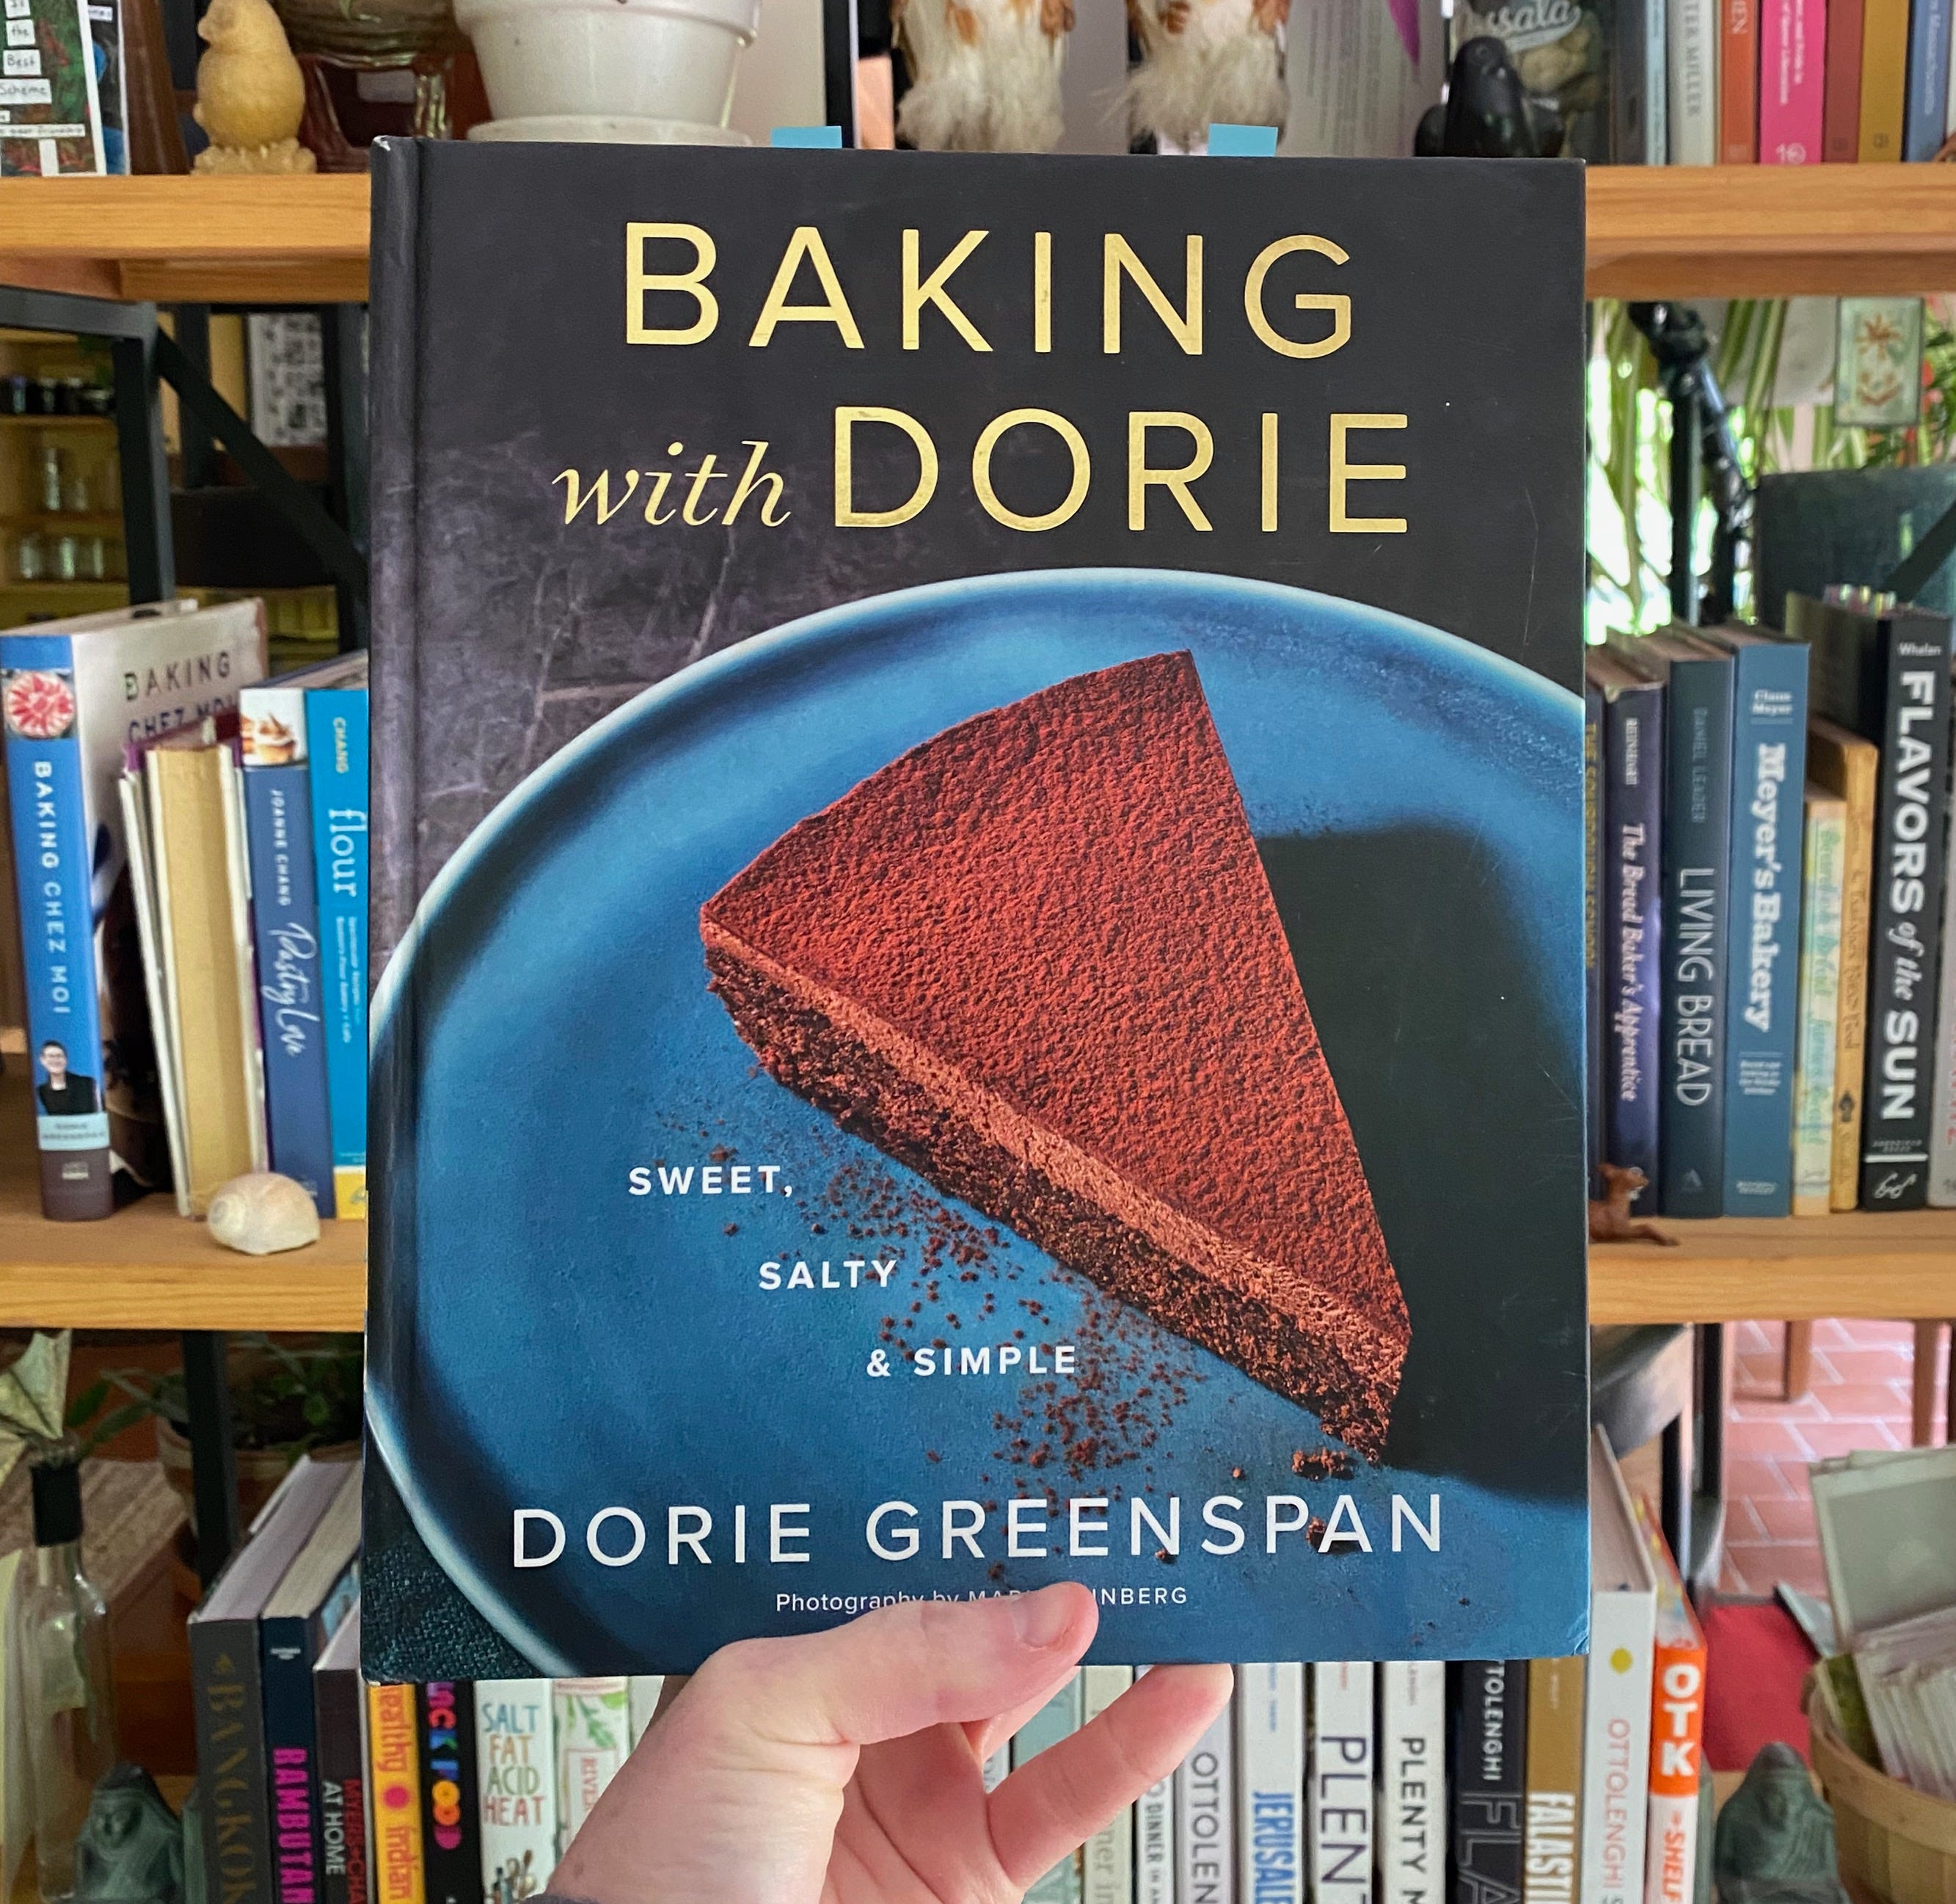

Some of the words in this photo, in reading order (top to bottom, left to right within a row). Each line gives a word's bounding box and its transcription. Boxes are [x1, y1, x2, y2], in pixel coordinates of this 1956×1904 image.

[7, 54, 34, 66] Best
[1686, 46, 1702, 117] MILLER
[625, 222, 1353, 360] BAKING
[552, 441, 792, 528] with
[835, 406, 1408, 533] DORIE
[124, 651, 230, 701] BAKING
[1899, 643, 1941, 657] Whelan
[333, 718, 348, 773] CHANG
[33, 761, 59, 868] BAKING
[271, 789, 287, 849] JOANNE
[1752, 743, 1786, 890] Meyer's
[1890, 670, 1935, 914] FLAVORS
[329, 809, 368, 897] flour
[1622, 822, 1646, 861] The
[275, 853, 291, 906] CHANG
[1621, 864, 1646, 923] Bread
[44, 881, 66, 952] CHEZ
[1678, 869, 1715, 982] LIVING
[1890, 921, 1924, 957] of
[52, 968, 71, 1013] MOI
[260, 922, 318, 1004] Pastry
[1745, 893, 1781, 1032] Bakery
[1896, 957, 1922, 1000] the
[1614, 999, 1644, 1101] Apprentice
[1677, 995, 1714, 1106] BREAD
[1882, 1010, 1919, 1119] SUN
[628, 1165, 793, 1197] SWEET,
[759, 1260, 897, 1290] SALTY
[866, 1349, 891, 1377] &
[913, 1346, 1076, 1376] SIMPLE
[513, 1503, 811, 1569] DORIE
[866, 1493, 1442, 1561] GREENSPAN
[1092, 1586, 1187, 1605] INBERG
[481, 1703, 541, 1734] SALT
[489, 1735, 533, 1764] FAT
[1484, 1661, 1504, 1781] TOLENGHI
[1661, 1664, 1700, 1776] OTK
[322, 1781, 344, 1805] AT
[430, 1759, 462, 1850] FOOD
[482, 1795, 545, 1826] HEAT
[486, 1766, 541, 1796] ACID
[1401, 1737, 1426, 1874] PLENTY
[1602, 1718, 1631, 1889] OTTOLENGHI
[273, 1747, 314, 1903] RAMBUTAN
[324, 1814, 346, 1875] HOME
[1146, 1803, 1163, 1863] DINNER
[1191, 1752, 1219, 1904] OTTOLEN
[385, 1825, 418, 1901] indian
[1662, 1830, 1685, 1902] SHELF
